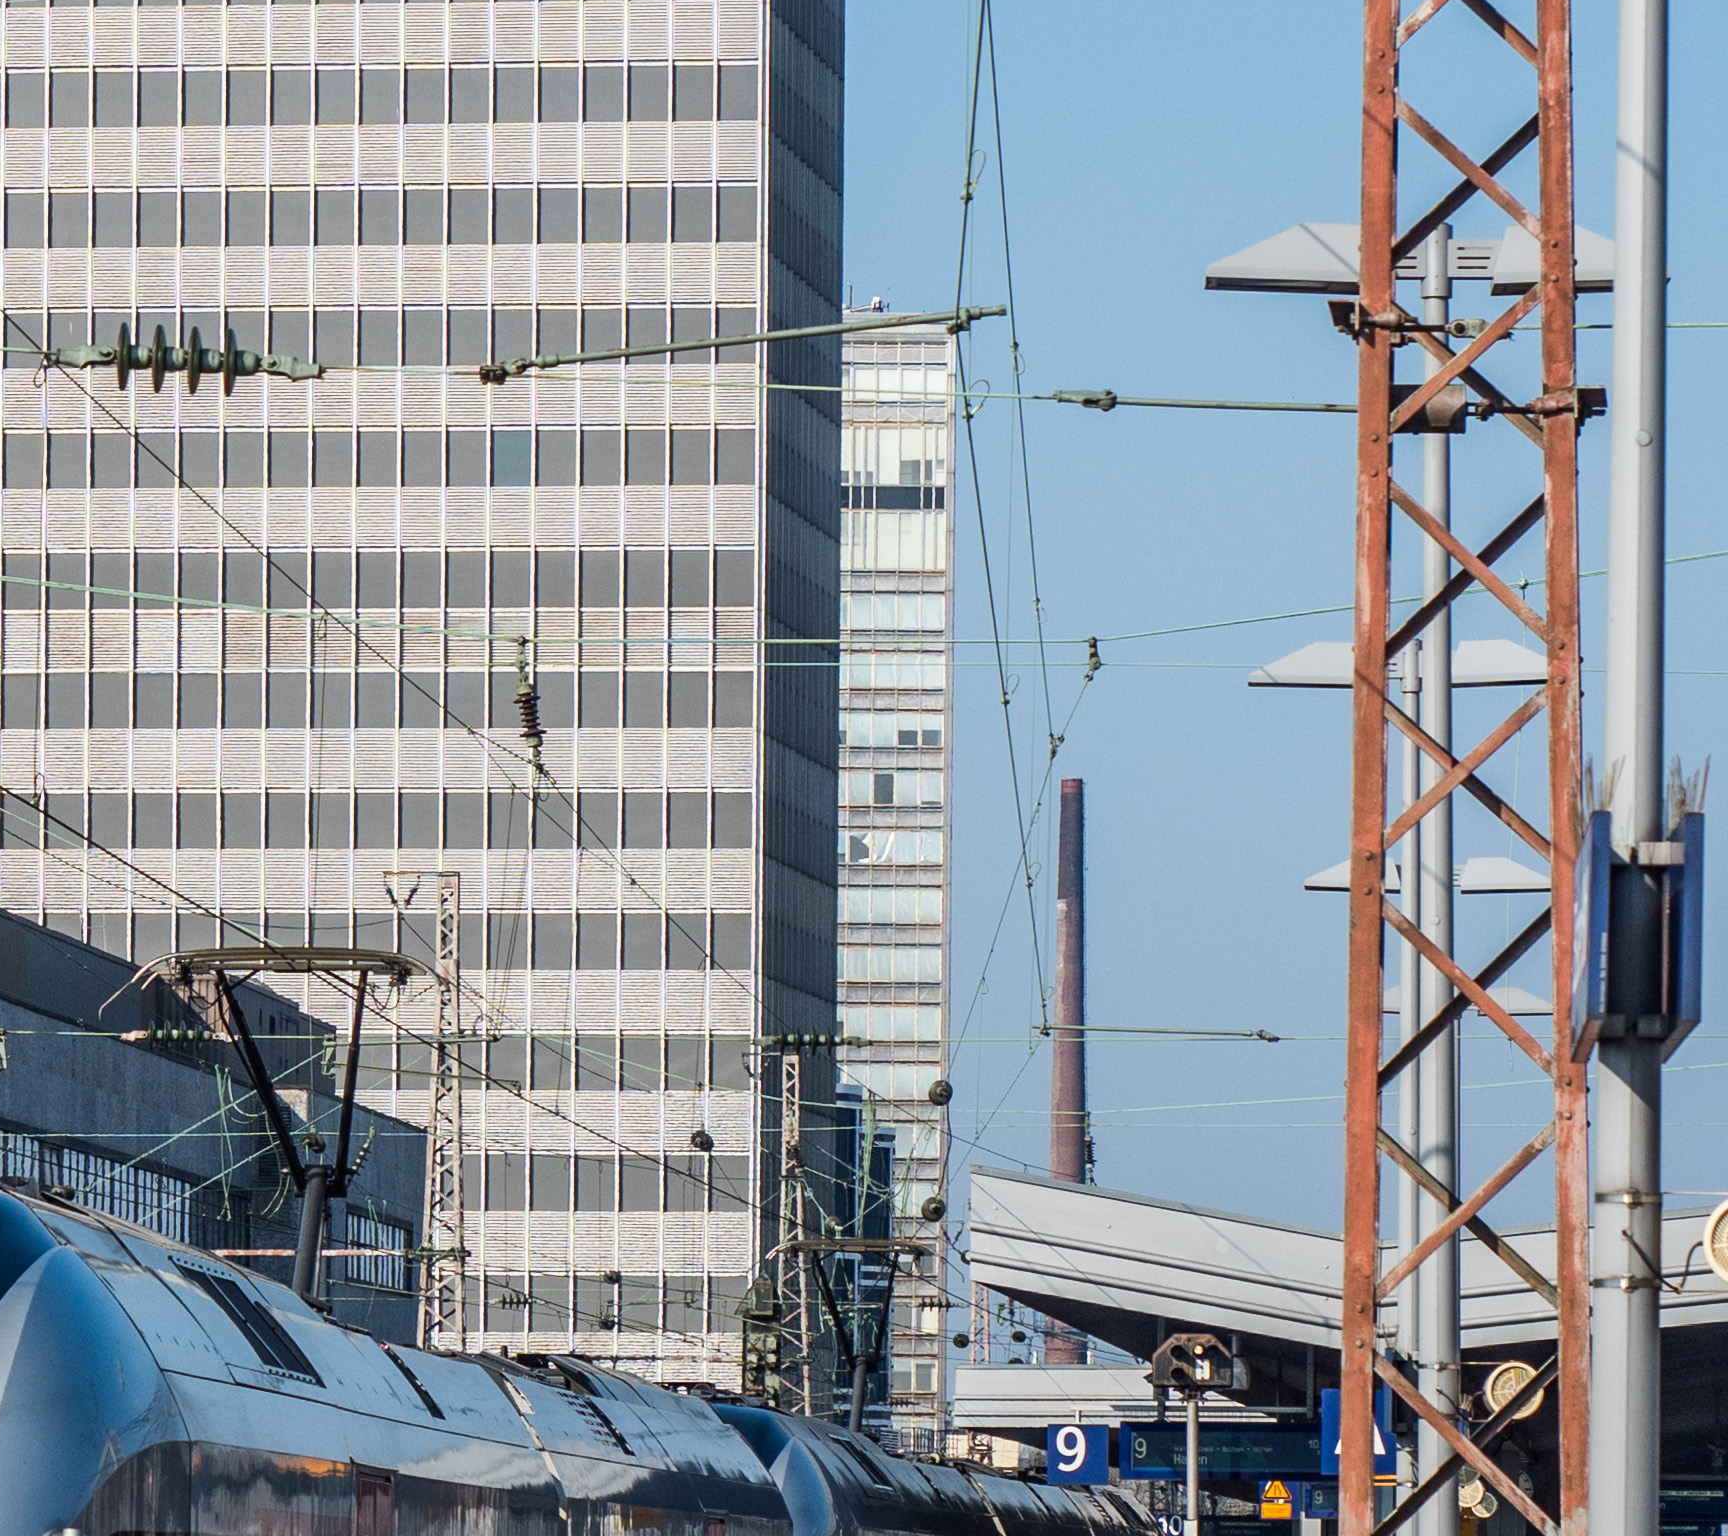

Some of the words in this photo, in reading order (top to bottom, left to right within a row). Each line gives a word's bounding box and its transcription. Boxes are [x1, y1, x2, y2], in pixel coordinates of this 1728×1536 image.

[1056, 1425, 1086, 1472] 9
[1134, 1437, 1147, 1459] 9
[1314, 1490, 1323, 1504] 9
[1158, 1515, 1182, 1536] 10
